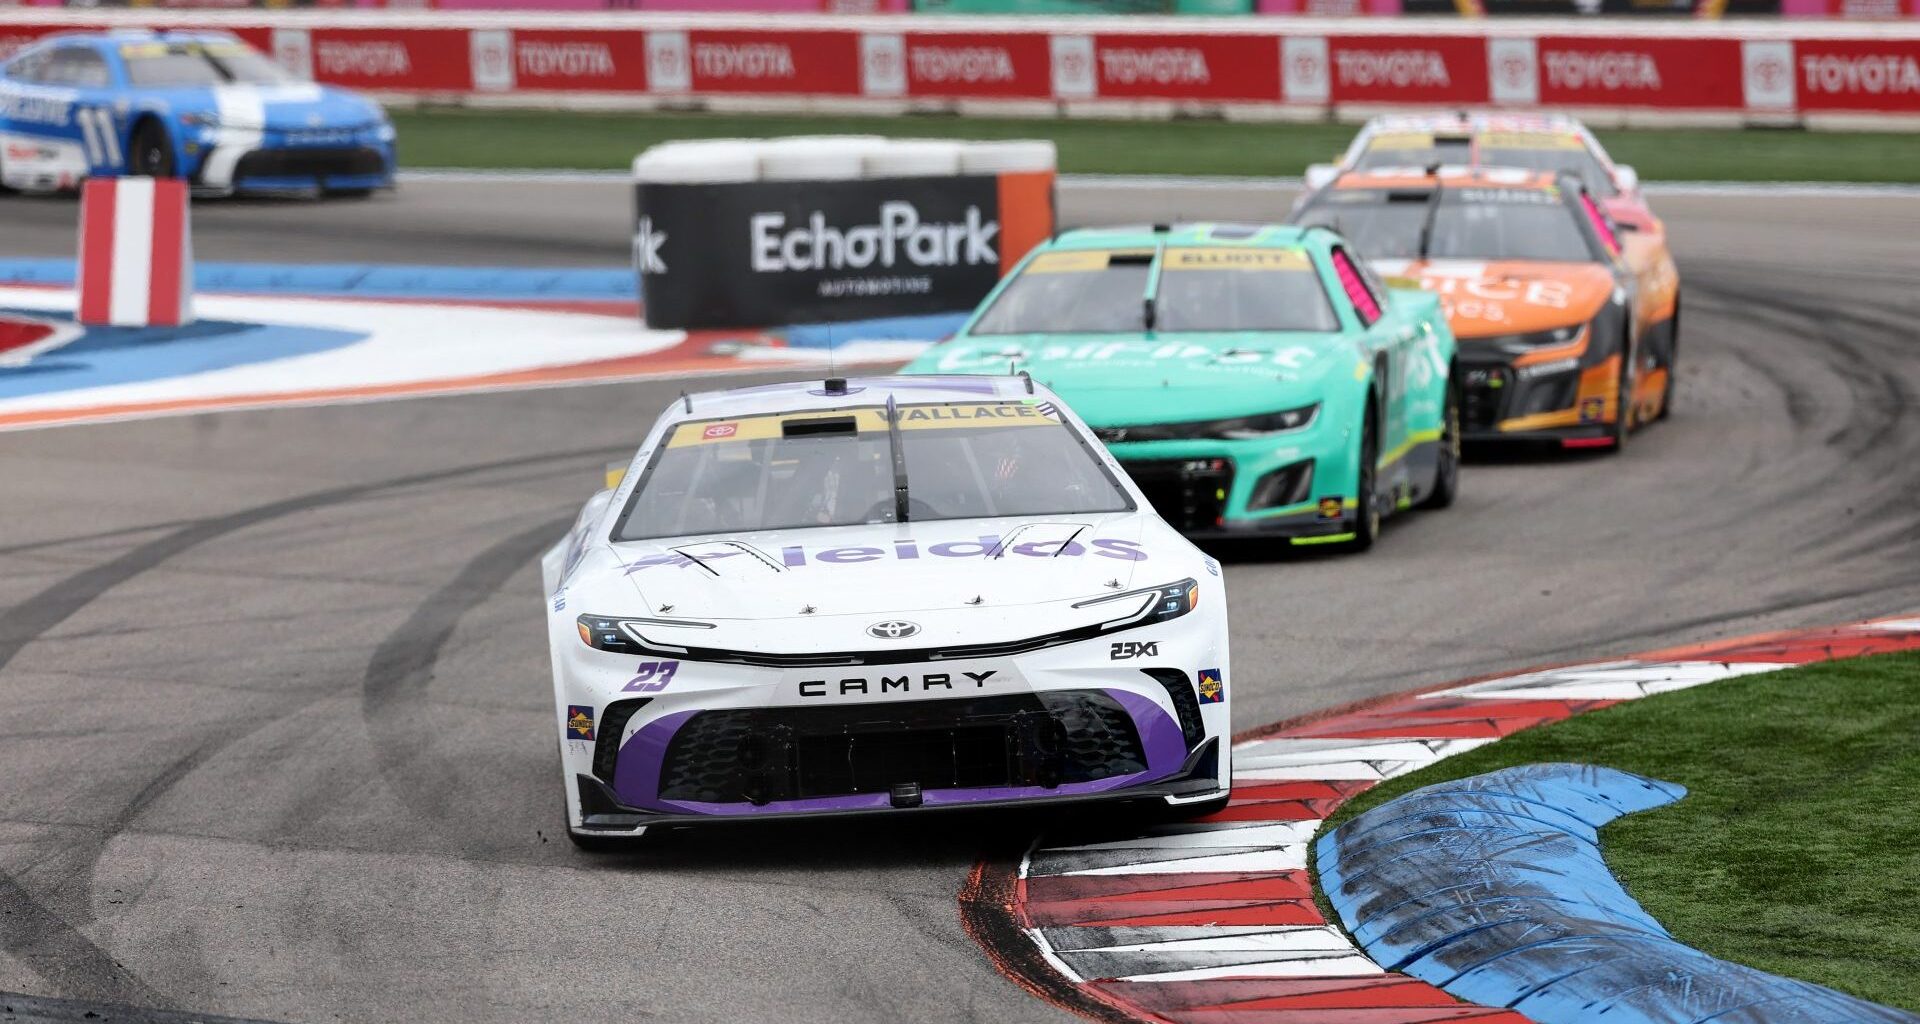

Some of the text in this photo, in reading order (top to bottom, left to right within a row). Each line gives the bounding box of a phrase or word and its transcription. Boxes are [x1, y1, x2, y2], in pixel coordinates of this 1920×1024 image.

[317, 41, 411, 75] TOYOTA
[518, 42, 615, 76] TOYOTA
[695, 43, 793, 79] TOYOTA
[911, 46, 1014, 82] TOYOTA
[1103, 48, 1210, 84] TOYOTA
[1337, 50, 1450, 87] TOYOTA
[1545, 51, 1661, 90] TOYOTA
[1803, 55, 1920, 94] TOYOTA
[78, 107, 123, 168] 11
[750, 202, 998, 272] EchoPark
[1181, 251, 1284, 264] ELLIOTT
[876, 404, 1037, 423] WALLACE
[782, 534, 1148, 567] leidos
[620, 661, 679, 692] 23
[799, 671, 998, 698] CAMRY
[1200, 681, 1221, 693] SUNOCO
[568, 718, 594, 729] SUNOCO
